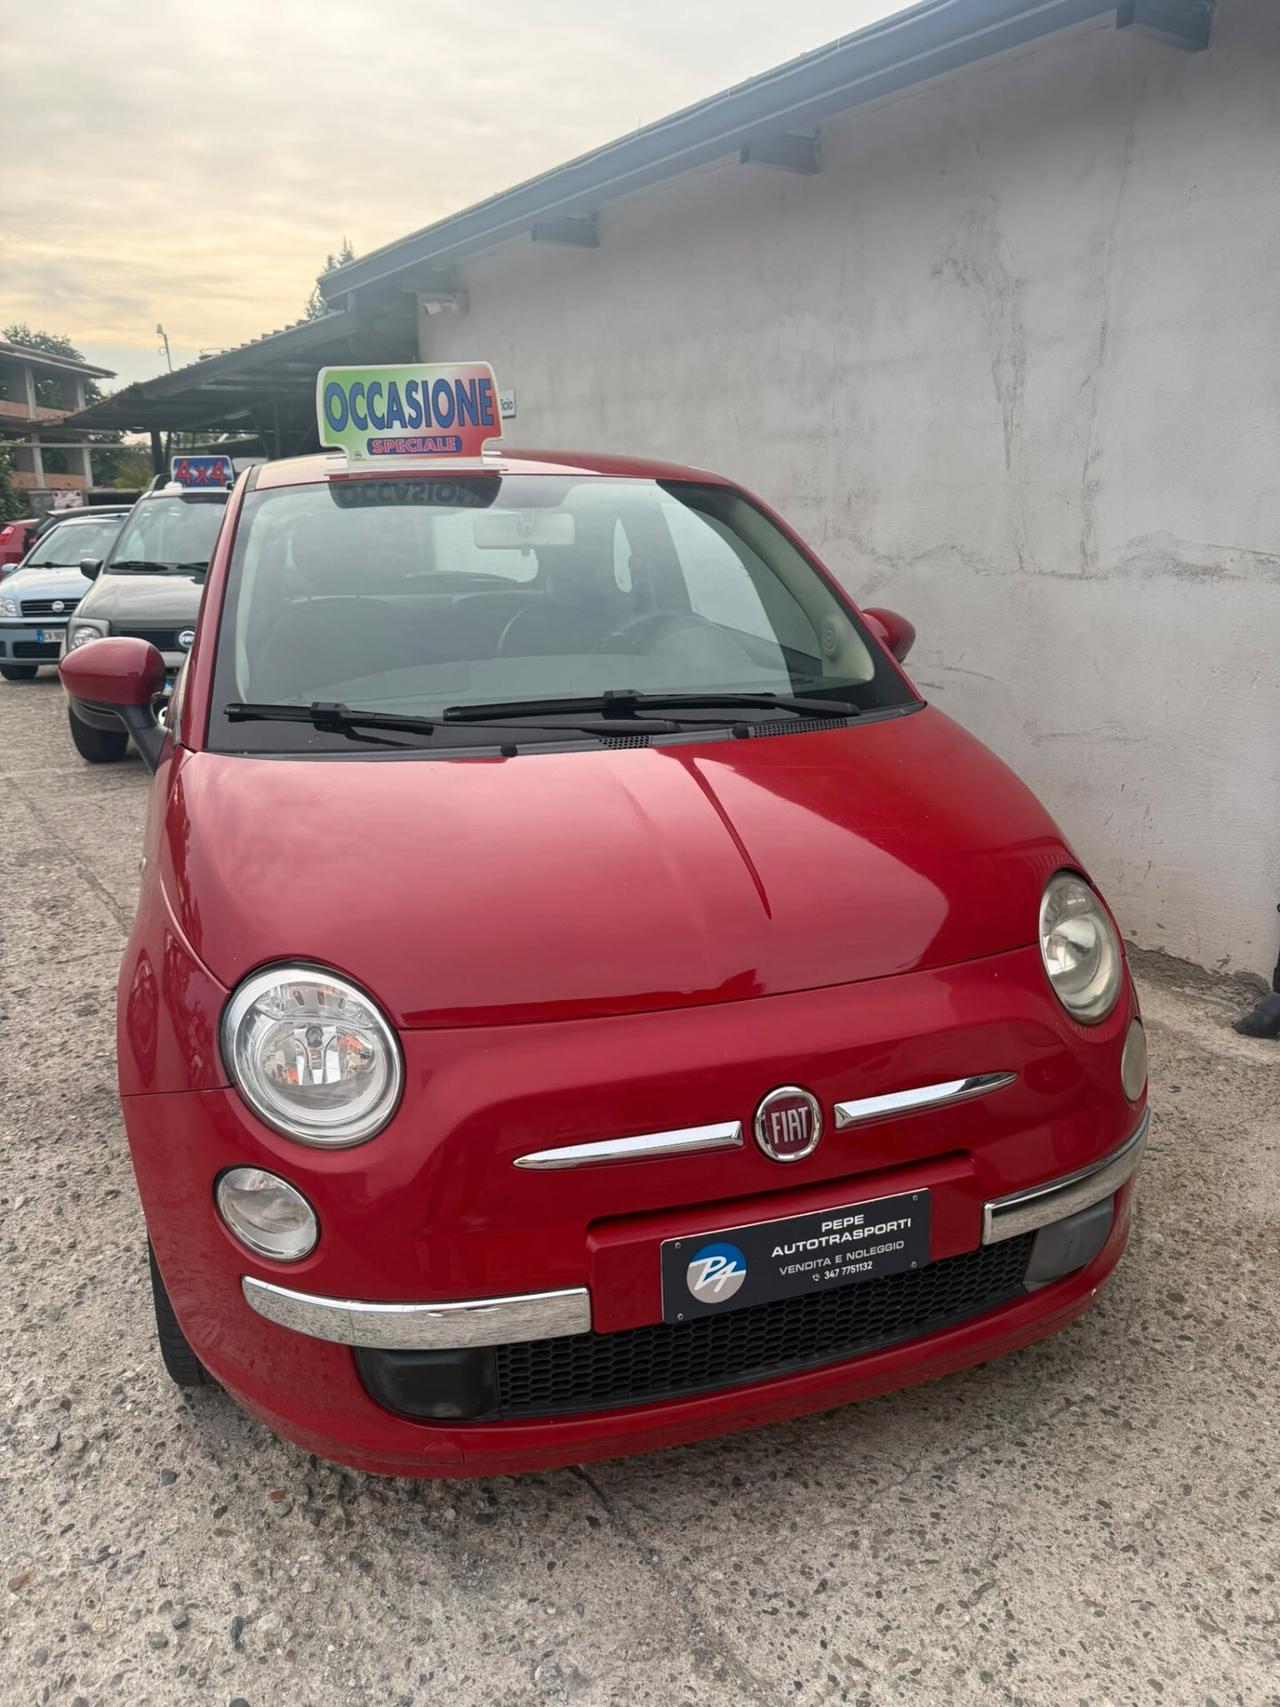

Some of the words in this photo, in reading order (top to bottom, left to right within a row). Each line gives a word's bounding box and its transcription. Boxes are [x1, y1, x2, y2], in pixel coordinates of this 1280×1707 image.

[324, 378, 495, 433] OCCASIONE
[371, 436, 457, 455] SPECIALE
[770, 1106, 809, 1145] FIAT
[771, 1217, 912, 1258] AUTOTRASPORTI
[821, 1214, 865, 1233] PEPE
[779, 1257, 832, 1276] VENDITA
[834, 1254, 843, 1264] E
[846, 1240, 905, 1262] NOLEGGIO
[824, 1268, 840, 1280] 347
